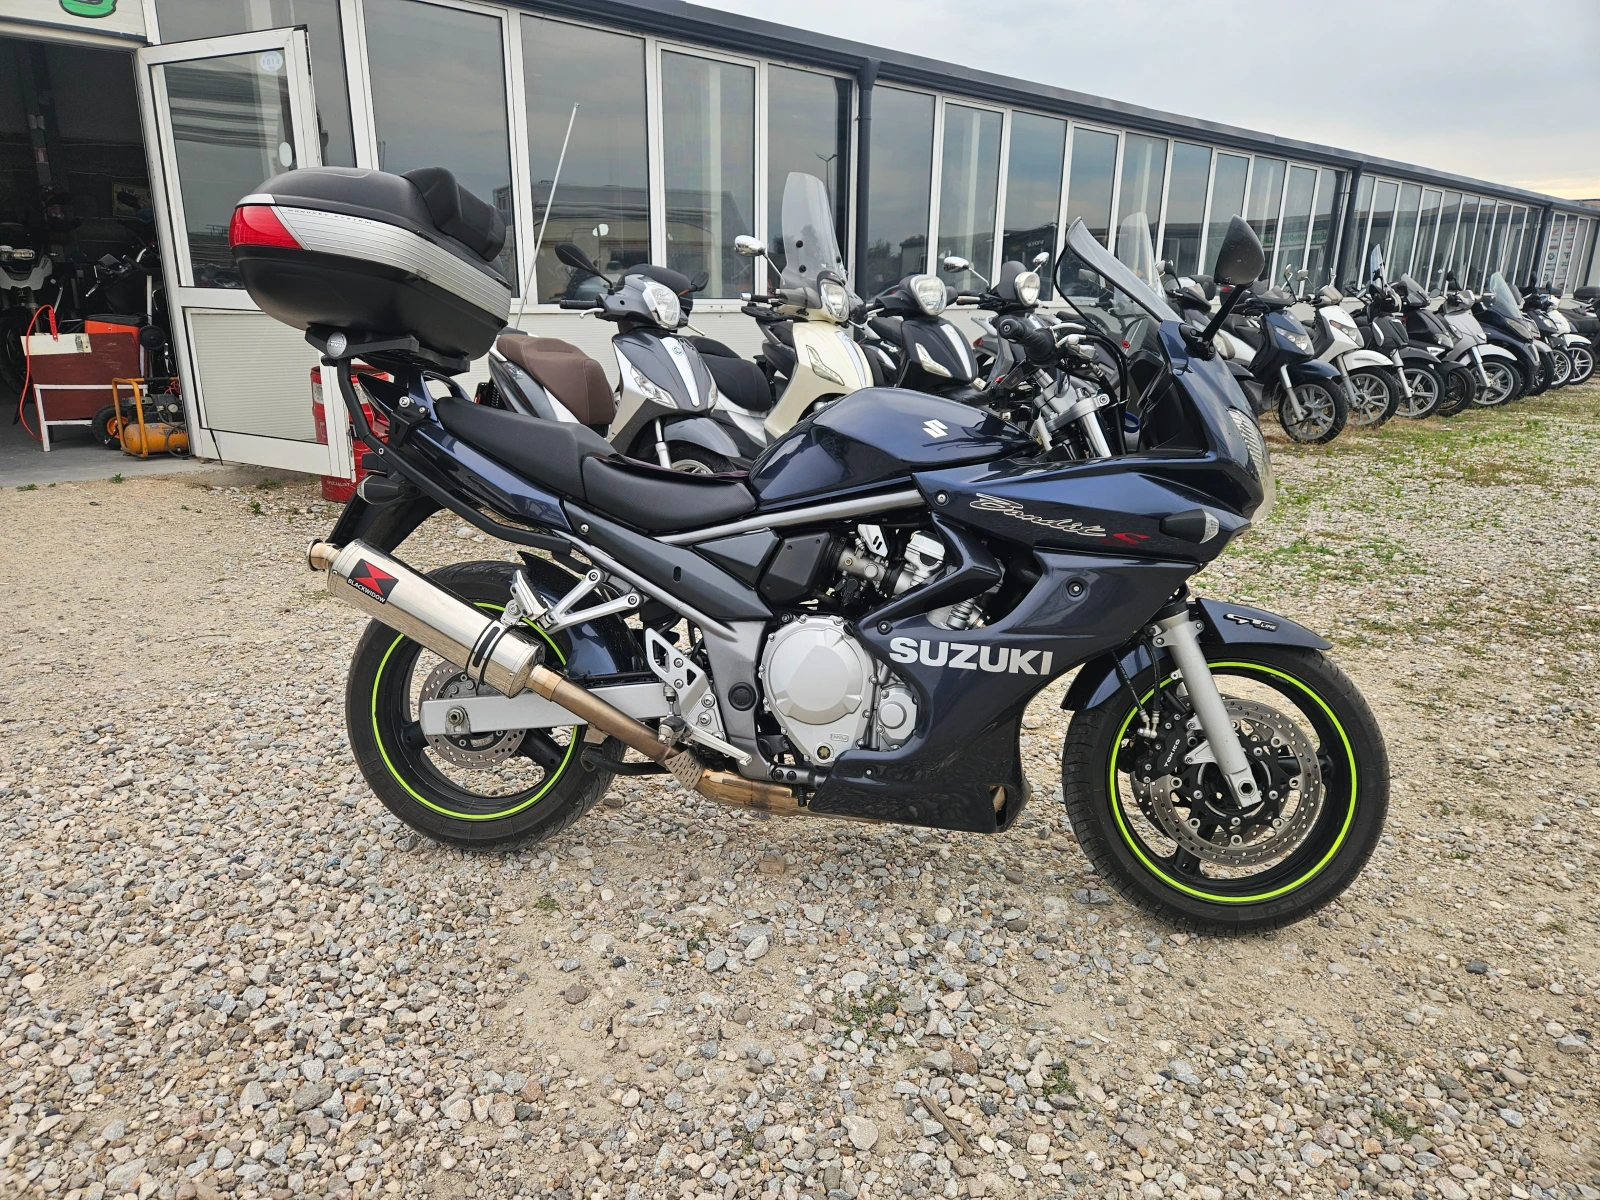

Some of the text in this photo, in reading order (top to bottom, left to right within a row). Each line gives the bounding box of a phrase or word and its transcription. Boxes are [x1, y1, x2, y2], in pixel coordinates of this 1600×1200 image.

[347, 578, 386, 603] BLACKWIDOW
[889, 636, 1054, 676] SUZUKI
[1163, 738, 1181, 768] TOKICO
